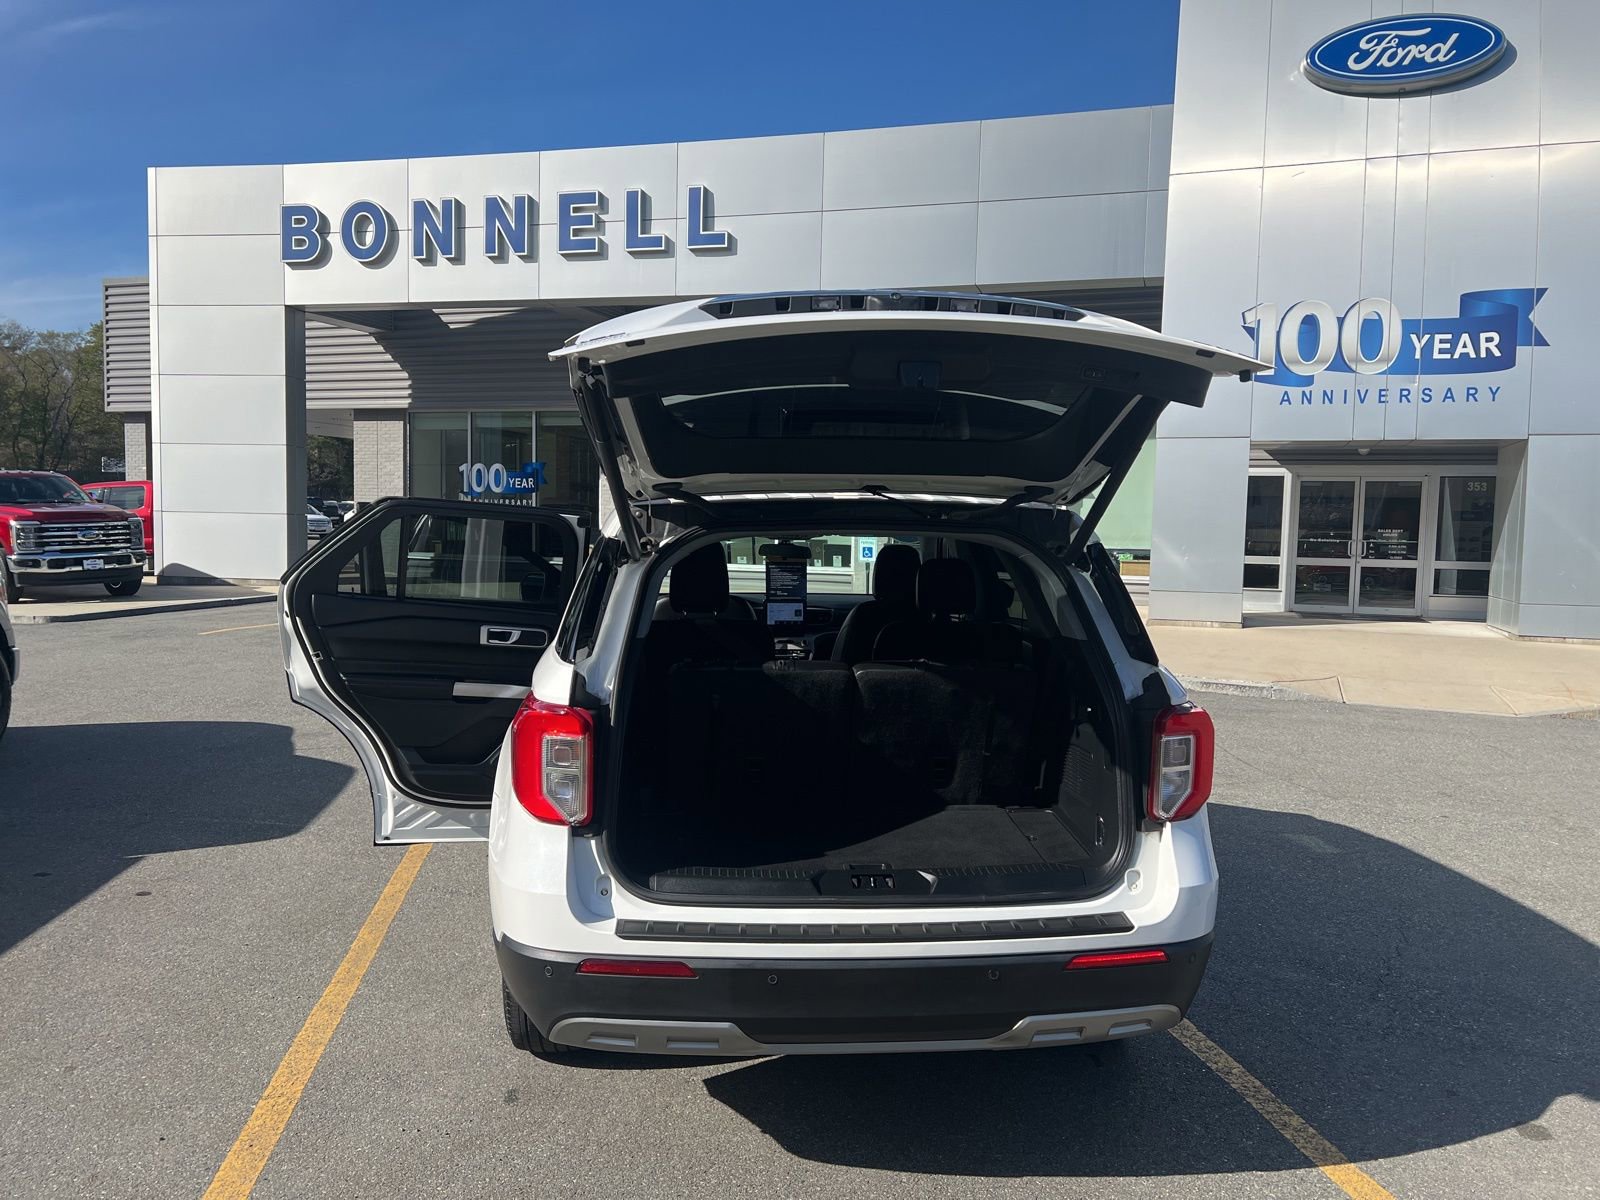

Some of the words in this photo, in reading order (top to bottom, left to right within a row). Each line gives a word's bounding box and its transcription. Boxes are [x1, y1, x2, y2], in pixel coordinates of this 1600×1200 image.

[1347, 27, 1460, 71] Ford
[280, 185, 732, 265] BONNELL
[1241, 297, 1402, 376] 100
[1409, 330, 1503, 360] YEAR
[1279, 385, 1503, 406] ANNIVERSARY
[458, 462, 507, 493] 100
[508, 477, 535, 489] YEAR
[1467, 481, 1488, 492] 353
